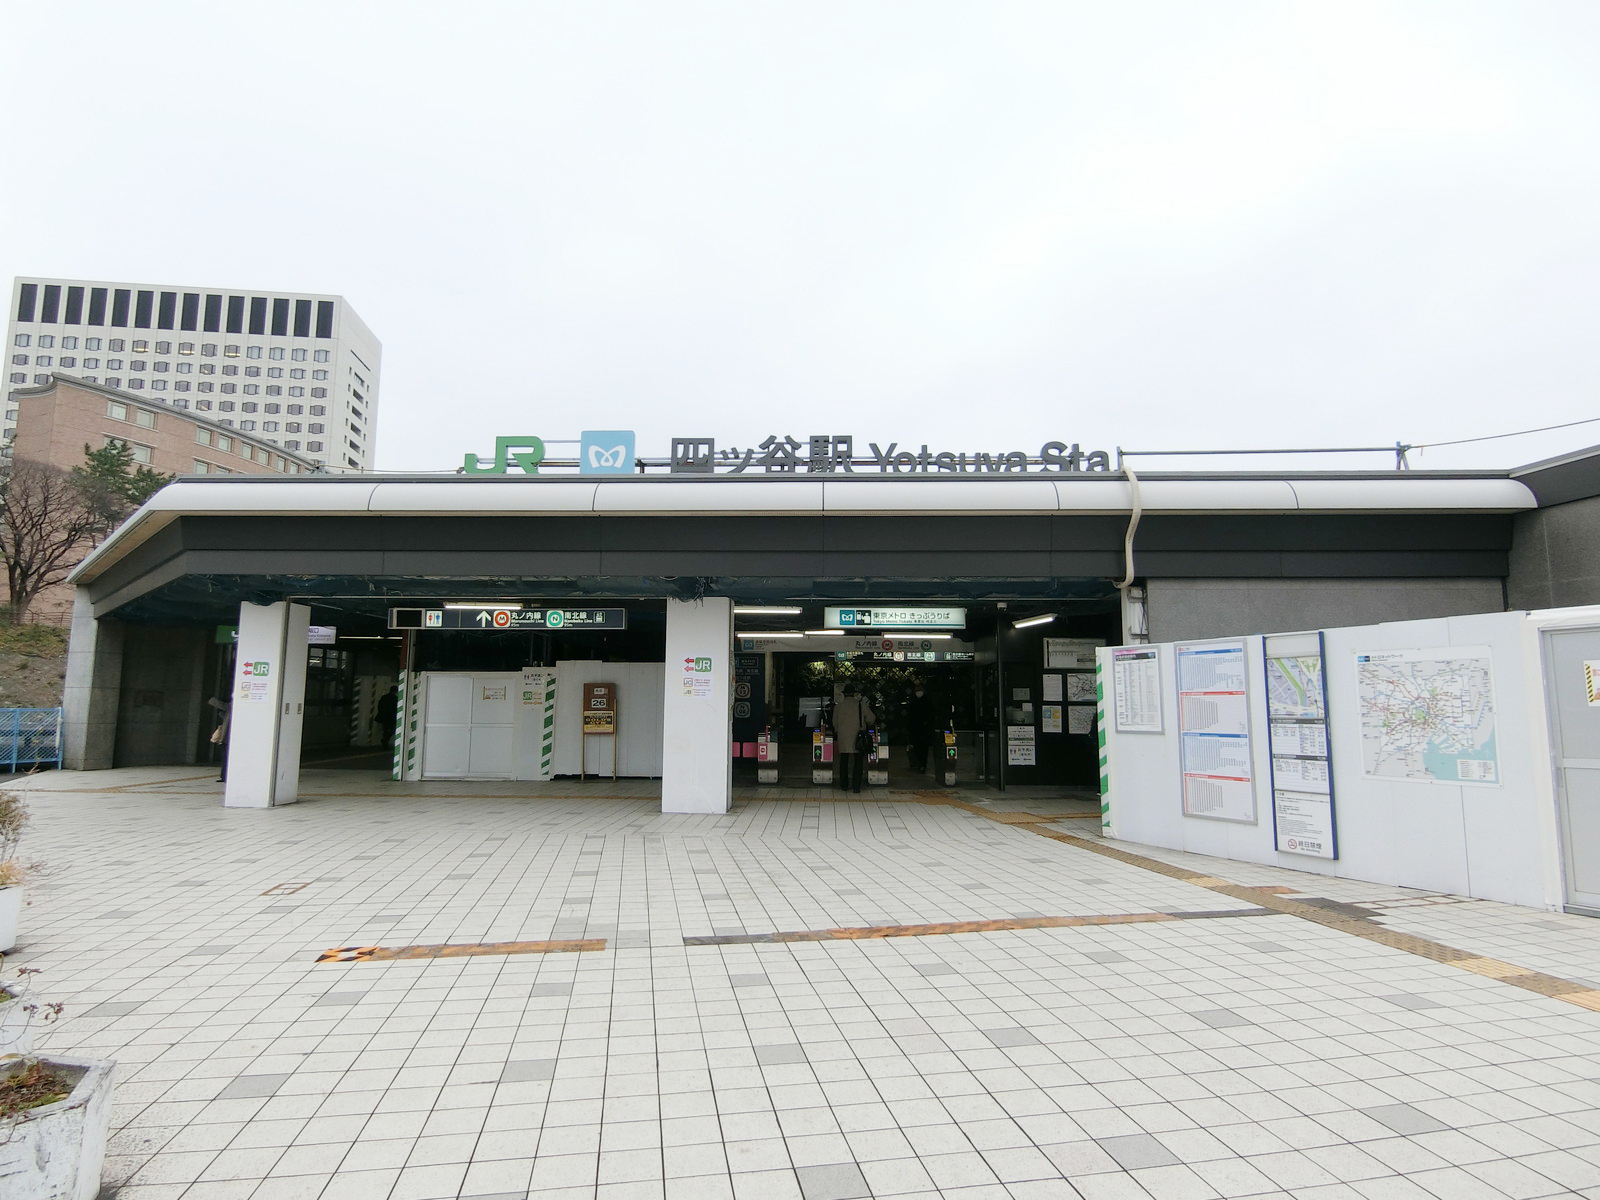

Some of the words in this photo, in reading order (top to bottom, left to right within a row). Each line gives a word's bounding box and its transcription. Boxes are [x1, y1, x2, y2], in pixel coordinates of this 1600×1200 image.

[464, 436, 545, 474] JR
[671, 435, 853, 473] 四ツ谷駅
[869, 443, 1028, 472] Yotsuya
[1040, 441, 1111, 472] Sta
[254, 664, 268, 674] JR
[696, 660, 710, 670] JR
